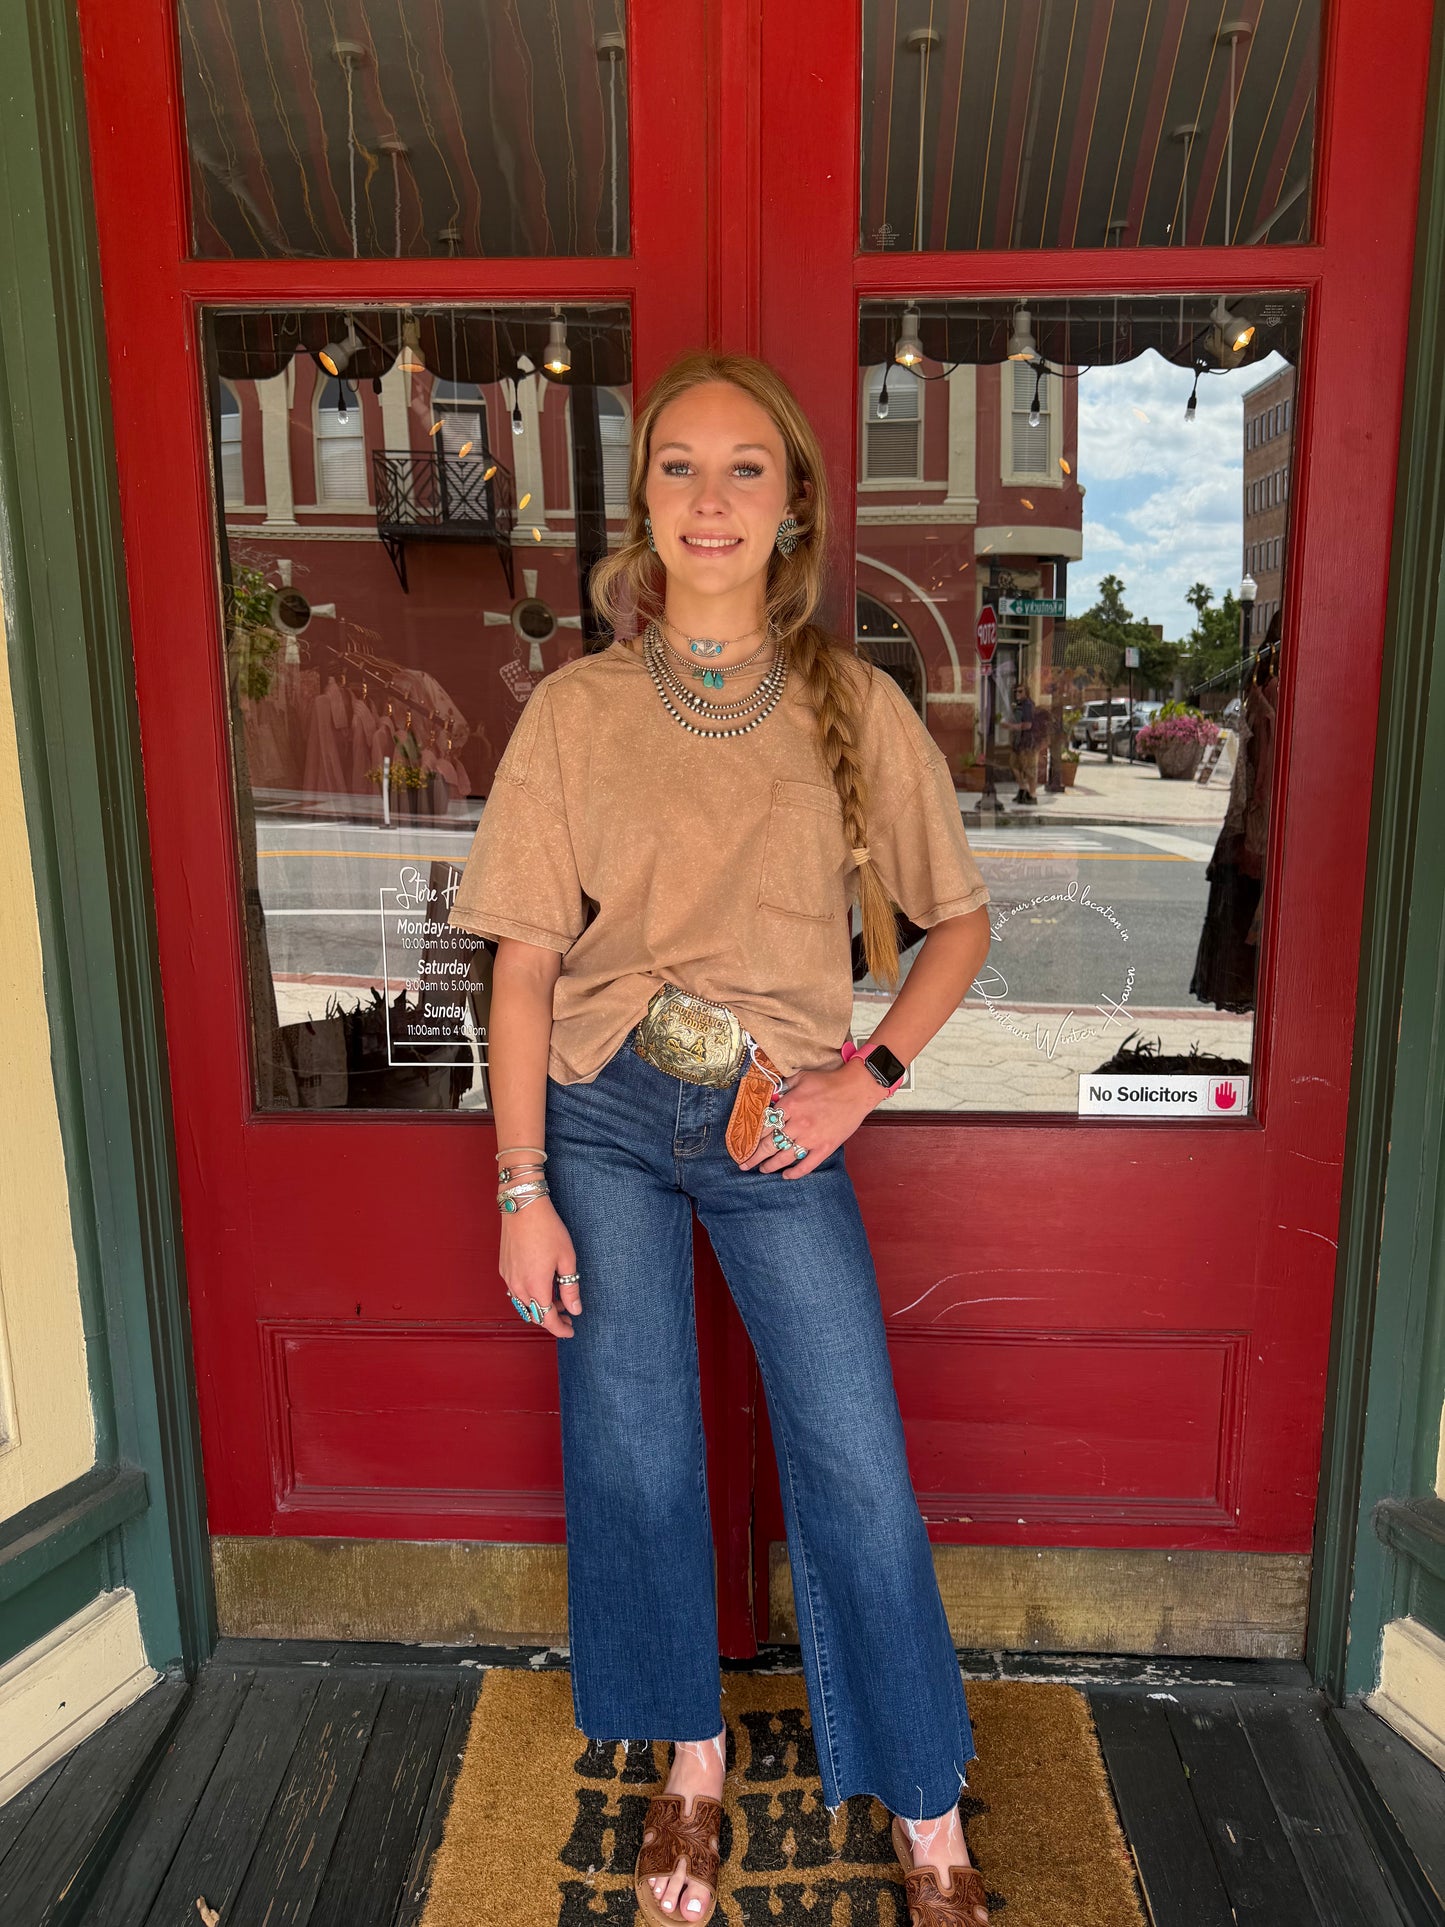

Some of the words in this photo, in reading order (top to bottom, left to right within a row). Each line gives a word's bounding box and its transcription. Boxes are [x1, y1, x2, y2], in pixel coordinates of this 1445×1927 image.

[396, 866, 438, 909] Store
[990, 911, 1010, 942] Visit
[1011, 903, 1030, 916] our
[1030, 881, 1079, 907] second
[1080, 885, 1122, 930] location
[1120, 928, 1129, 942] in
[401, 937, 438, 949] 10:00am
[440, 938, 449, 949] to
[417, 959, 471, 978] Saturday
[405, 979, 438, 991] 9:00am
[440, 980, 449, 991] to
[423, 1002, 467, 1021] Sunday
[669, 1001, 698, 1019] YOUTH
[698, 1012, 729, 1031] RANCH
[970, 965, 1031, 1041] Downtown
[1036, 1010, 1097, 1060] Winter
[1095, 966, 1136, 1031] Haven
[407, 1024, 441, 1036] 11:00am
[442, 1025, 451, 1036] to
[679, 1015, 711, 1035] RODEO
[1089, 1086, 1113, 1102] No
[1117, 1086, 1198, 1102] Solicitors
